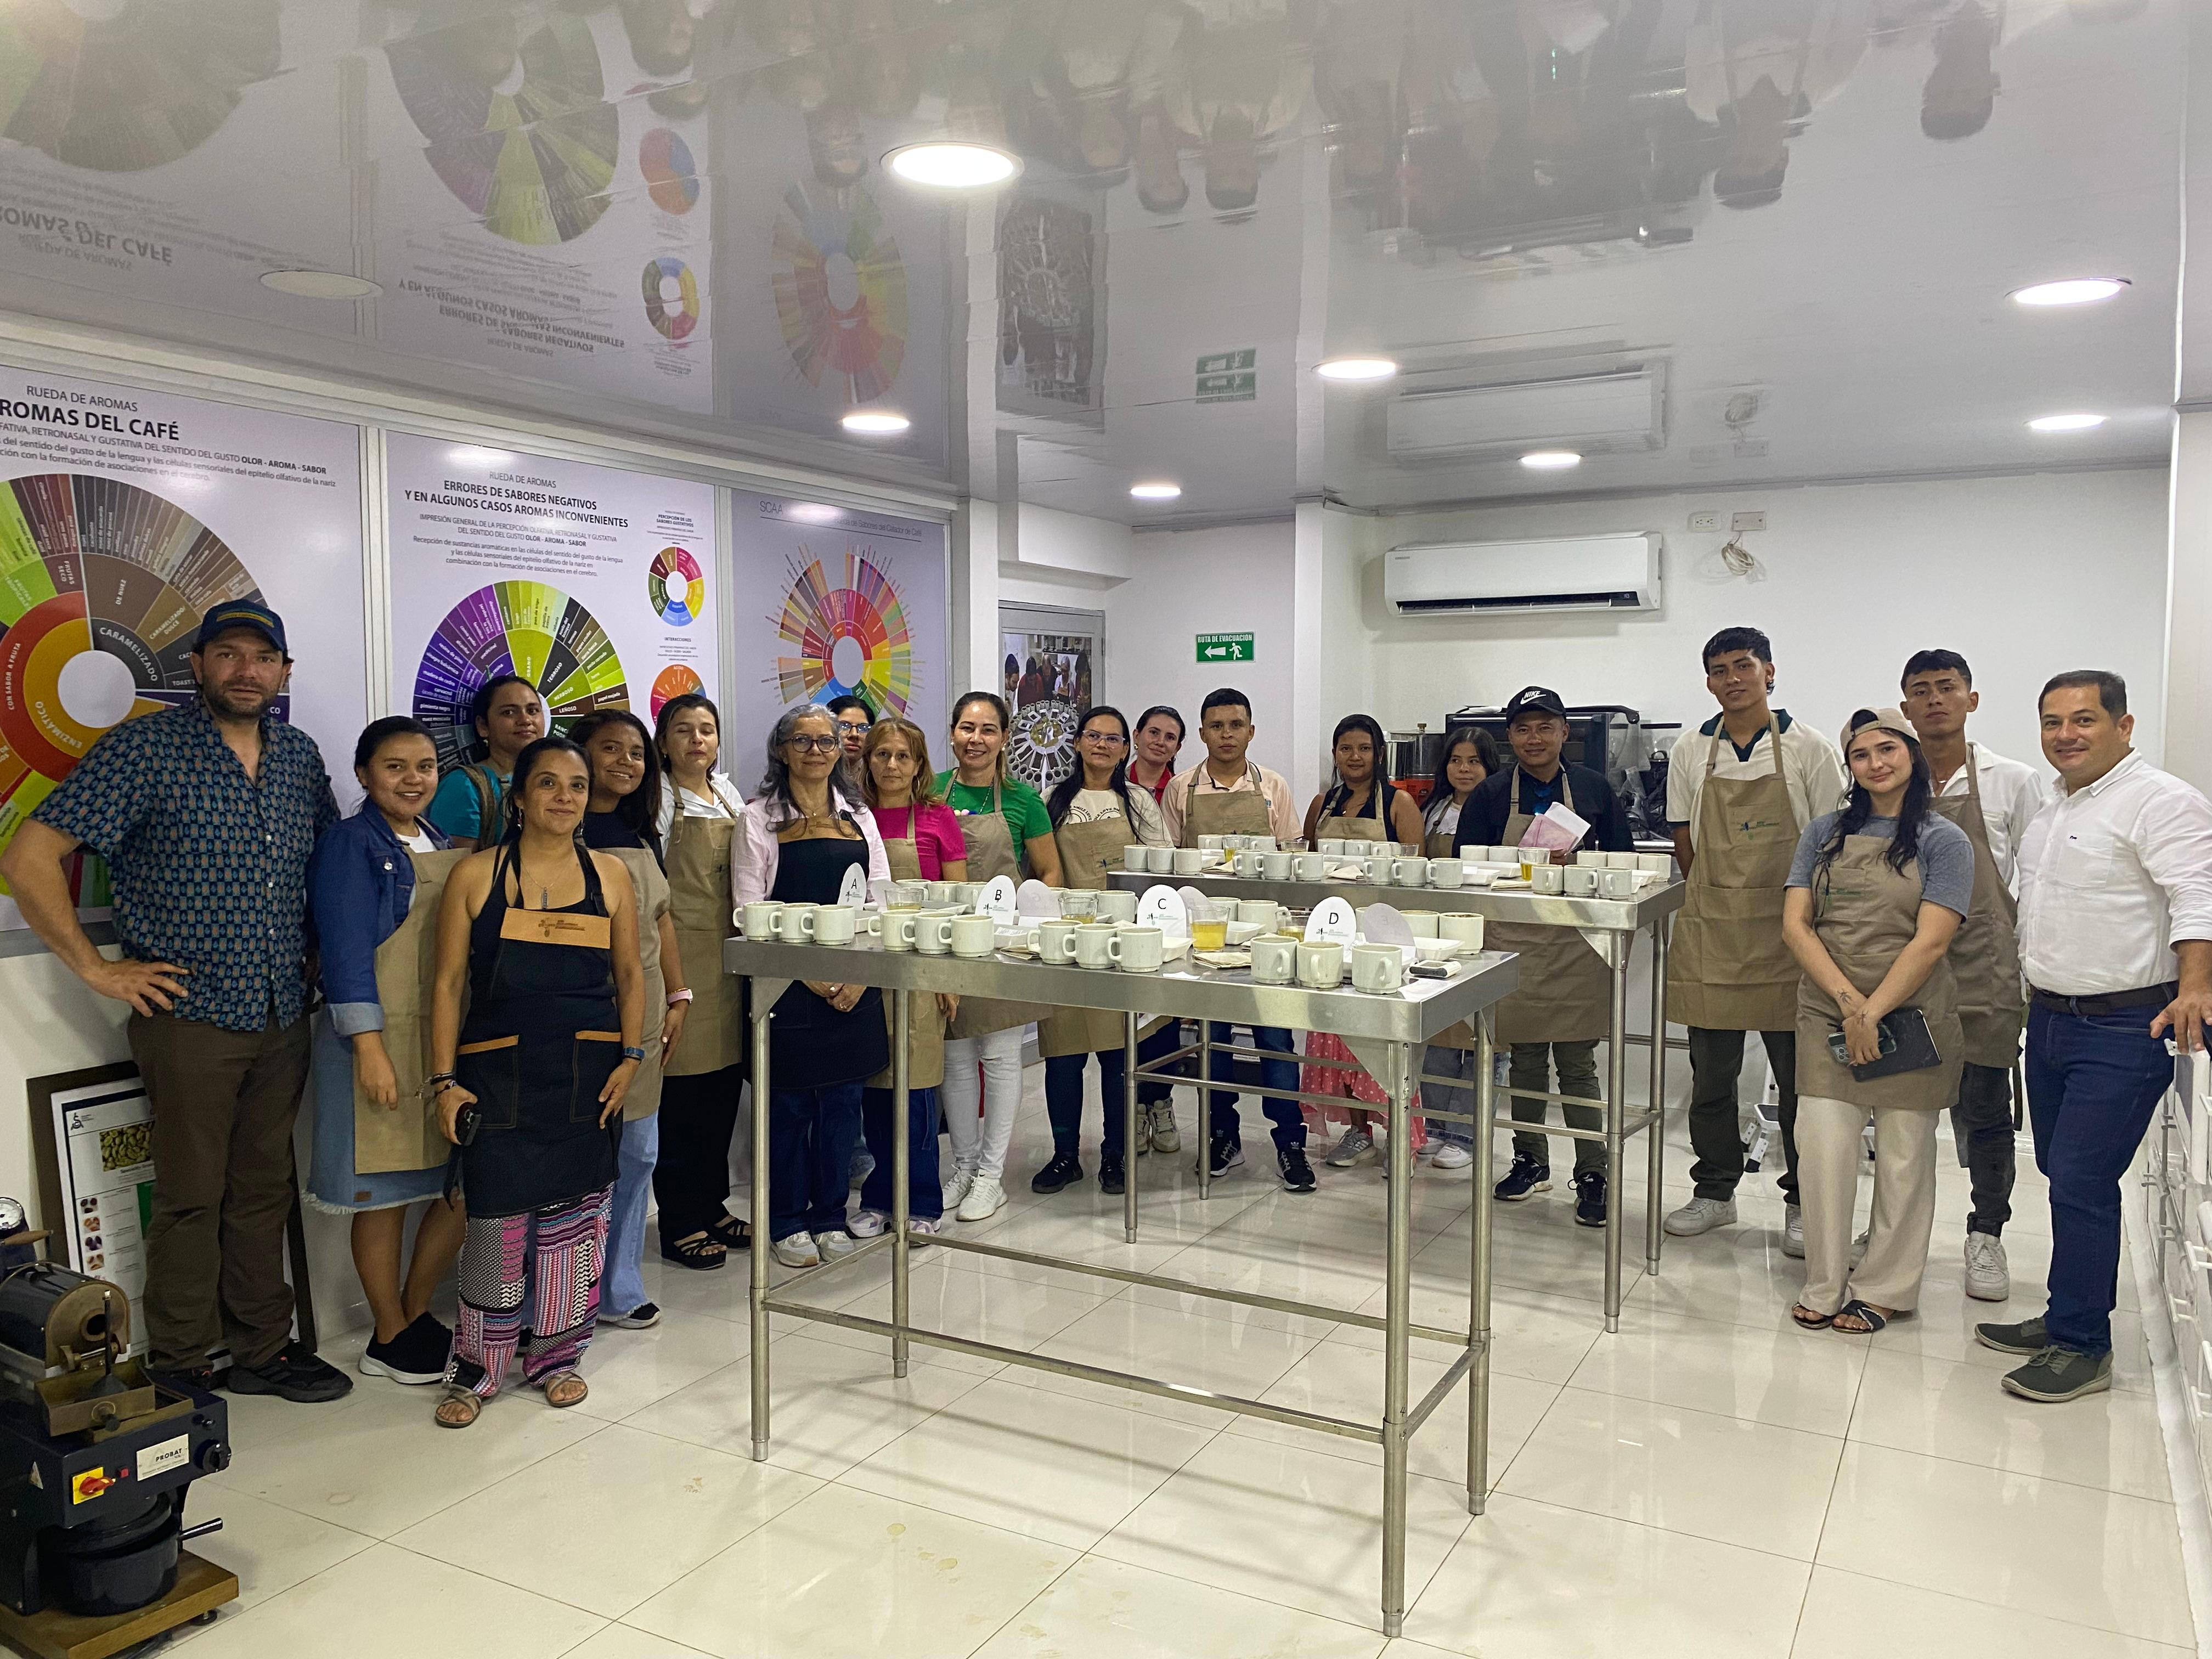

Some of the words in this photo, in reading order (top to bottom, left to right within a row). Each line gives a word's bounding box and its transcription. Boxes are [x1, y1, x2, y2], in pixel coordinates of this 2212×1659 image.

[27, 385, 67, 402] RUEDA
[71, 392, 86, 404] DE
[89, 395, 138, 411] AROMAS
[0, 399, 79, 426] ROMAS
[84, 411, 124, 432] DEL
[129, 420, 179, 441] CAFÉ
[31, 426, 89, 442] RETRONASAL
[91, 435, 97, 443] Y
[98, 436, 143, 449] GUSTATIVA
[145, 442, 160, 452] DEL
[162, 444, 196, 457] SENTIDO
[198, 450, 212, 459] DEL
[214, 452, 240, 462] GUSTO
[241, 456, 262, 466] OLOR
[268, 460, 296, 470] AROMA
[302, 465, 327, 474] SABOR
[3, 437, 17, 445] del
[19, 437, 53, 450] sentido
[54, 443, 69, 452] del
[70, 445, 94, 456] gusto
[95, 448, 106, 457] de
[108, 449, 116, 459] la
[117, 451, 145, 465] lengua
[146, 457, 152, 465] y
[153, 455, 165, 465] las
[193, 462, 234, 475] sensoriales
[235, 466, 247, 476] del
[248, 469, 275, 480] epitelio
[275, 472, 302, 483] olfativo
[303, 475, 312, 484] de
[313, 477, 319, 485] la
[320, 479, 336, 487] nariz
[21, 451, 38, 460] con
[40, 450, 48, 461] la
[49, 454, 93, 467] formación
[94, 458, 106, 468] de
[107, 461, 158, 476] asociaciones
[489, 471, 514, 483] RUEDA
[516, 475, 525, 484] DE
[527, 477, 557, 489] AROMAS
[444, 480, 488, 495] ERRORES
[490, 487, 503, 498] DE
[504, 489, 546, 504] SABORES
[548, 494, 597, 510] NEGATIVOS
[405, 490, 412, 500] Y
[414, 491, 428, 503] EN
[430, 493, 478, 509] ALGUNOS
[481, 500, 512, 513] CASOS
[515, 504, 554, 518] AROMAS
[556, 510, 629, 528] INCONVENIENTES
[760, 500, 783, 514] SCAA
[420, 514, 452, 523] IMPRESIÓN
[452, 517, 478, 527] GENERAL
[495, 522, 528, 532] PERCEPCIÓN
[591, 534, 618, 542] GUSTATIVA
[458, 526, 469, 534] DEL
[470, 528, 494, 537] SENTIDO
[858, 520, 878, 530] Sabores
[413, 535, 443, 545] Recepción
[452, 540, 480, 549] sustancias
[481, 543, 510, 552] aromáticas
[483, 552, 512, 560] sensoriales
[64, 560, 75, 585] FRUTAS
[445, 557, 482, 566] combinación
[499, 562, 526, 570] formación
[534, 566, 566, 574] asociaciones
[118, 579, 127, 594] NUEZ
[115, 594, 122, 605] DE
[163, 620, 180, 635] DULCE
[1219, 634, 1252, 642] EVACUACION
[10, 642, 21, 661] FRUTA
[99, 627, 158, 682] CARAMELIZADO
[481, 642, 498, 659] medicinal
[546, 662, 563, 683] TERROSO
[554, 686, 574, 701] HERBOSO
[1523, 690, 1541, 699] NIKE
[559, 705, 577, 713] LEÑOSO
[851, 878, 857, 889] A
[995, 889, 1002, 900] B
[1158, 898, 1167, 910] C
[1329, 912, 1339, 924] D
[155, 1448, 182, 1462] PROBAT
